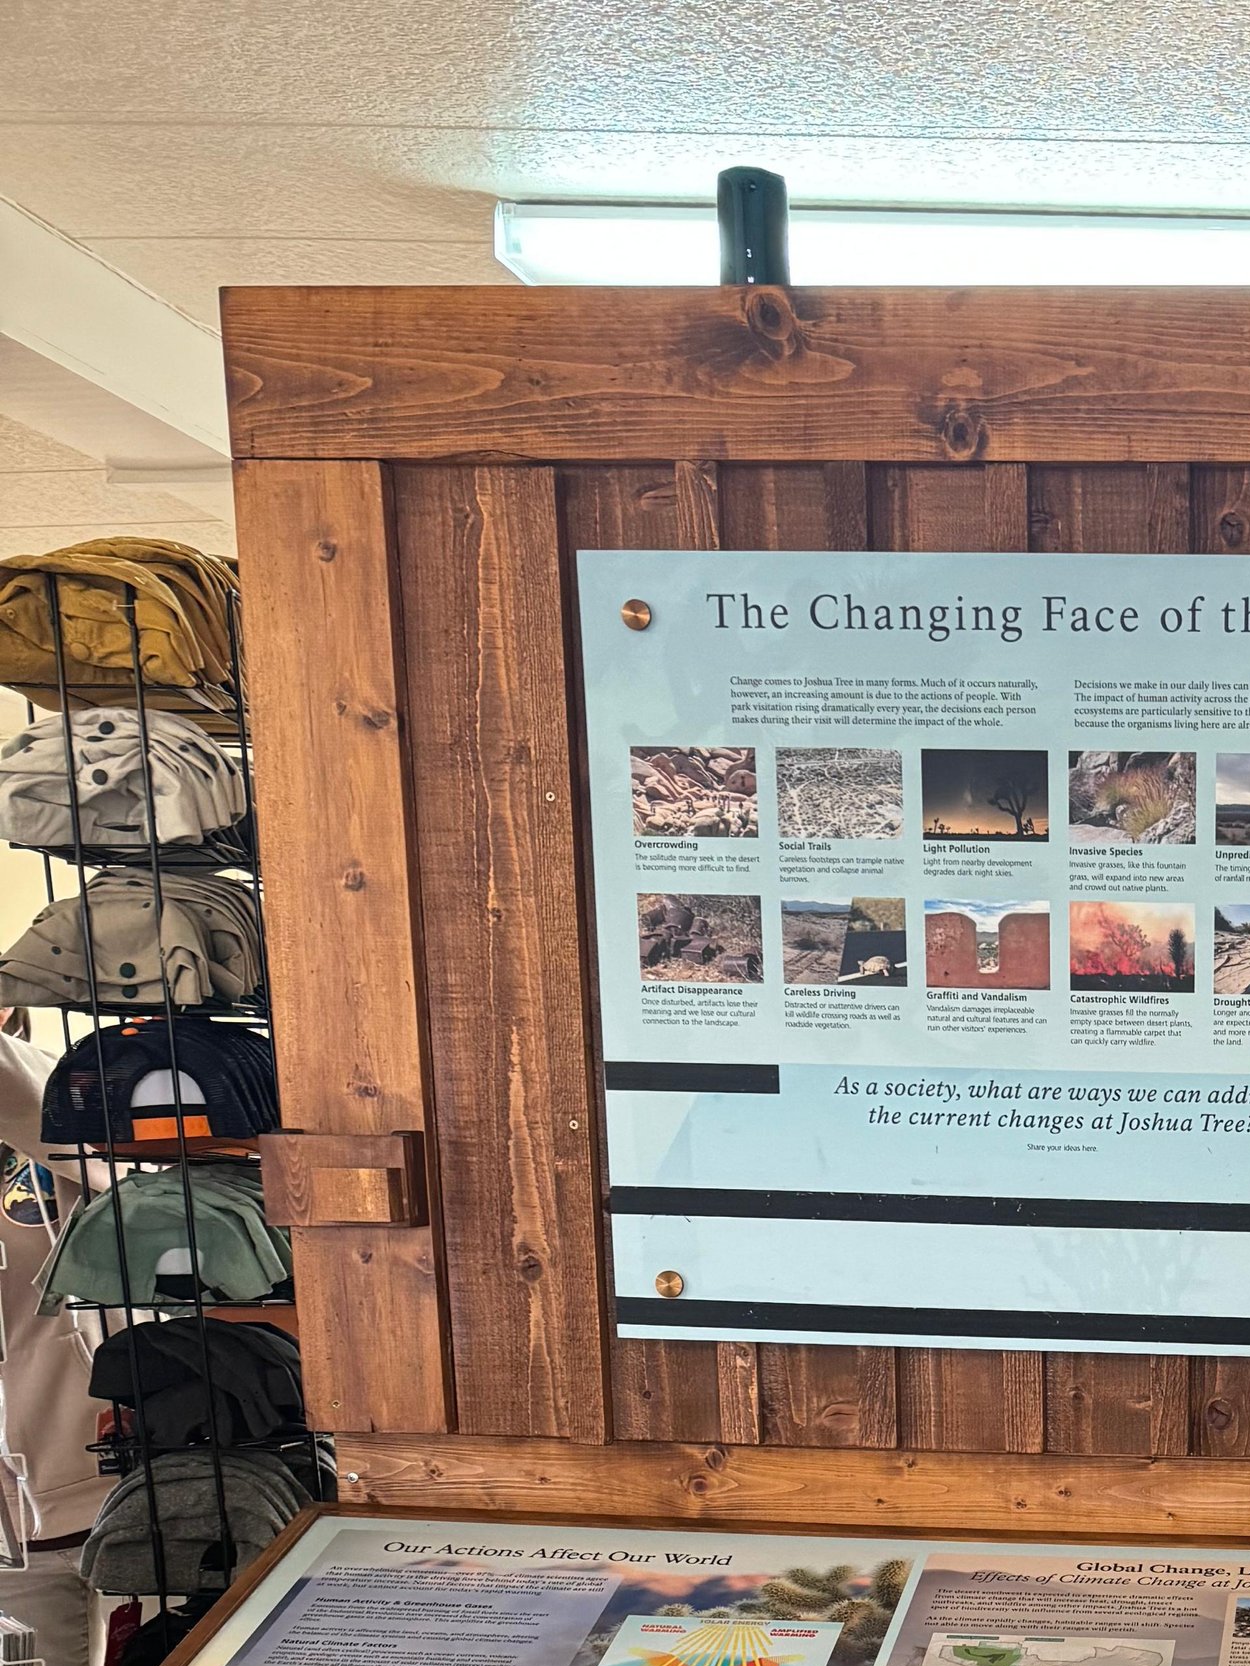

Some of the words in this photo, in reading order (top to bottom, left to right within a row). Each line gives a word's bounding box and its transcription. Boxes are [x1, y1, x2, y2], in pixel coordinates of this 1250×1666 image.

[706, 592, 789, 629] The
[809, 593, 1022, 643] Changing
[1041, 596, 1139, 632] Face
[1160, 595, 1205, 633] of
[729, 676, 763, 688] Change
[763, 678, 792, 686] comes
[792, 678, 803, 686] to
[803, 676, 833, 688] Joshua
[833, 676, 854, 686] Tree
[855, 678, 864, 687] in
[865, 679, 889, 689] many
[891, 677, 919, 687] forms.
[920, 677, 946, 687] Much
[947, 677, 958, 687] of
[958, 678, 965, 688] it
[966, 680, 996, 688] occurs
[997, 679, 1038, 691] naturally,
[634, 839, 698, 851] Overcrowding
[778, 841, 805, 850] Social
[807, 841, 831, 851] Trails
[923, 843, 947, 855] Light
[948, 844, 990, 854] Pollution
[1069, 846, 1107, 855] Invasive
[1109, 847, 1143, 858] Species
[641, 984, 675, 994] Artifact
[677, 985, 743, 996] Disappearance
[783, 987, 821, 997] Careless
[823, 988, 856, 999] Driving
[926, 991, 959, 1000] Graffiti
[961, 992, 979, 1001] and
[980, 992, 1027, 1001] Vandalism
[1070, 994, 1127, 1005] Catastrophic
[1128, 995, 1169, 1005] Wildfires
[1213, 997, 1250, 1008] Drought
[833, 1076, 859, 1095] As
[865, 1081, 878, 1095] a
[883, 1078, 961, 1103] society,
[967, 1079, 1023, 1099] what
[1027, 1086, 1062, 1100] are
[1067, 1087, 1122, 1107] ways
[1127, 1088, 1157, 1102] we
[1163, 1089, 1201, 1103] can
[868, 1105, 901, 1124] the
[908, 1110, 991, 1127] current
[997, 1108, 1084, 1134] changes
[1091, 1113, 1114, 1130] at
[1119, 1111, 1193, 1133] Joshua
[1026, 1143, 1046, 1151] Share
[1063, 1144, 1081, 1152] ideas
[1081, 1144, 1097, 1152] here.
[383, 1541, 432, 1553] Our
[434, 1543, 524, 1557] Actions
[528, 1548, 603, 1561] Affect
[608, 1550, 656, 1563] Our
[664, 1553, 733, 1566] World
[1076, 1562, 1143, 1573] Global
[1149, 1561, 1231, 1574] Change,
[970, 1571, 1030, 1582] Effects
[1036, 1572, 1057, 1583] of
[1058, 1574, 1131, 1585] Climate
[1136, 1573, 1207, 1586] Change
[1210, 1576, 1231, 1585] at
[321, 1639, 359, 1647] Climate
